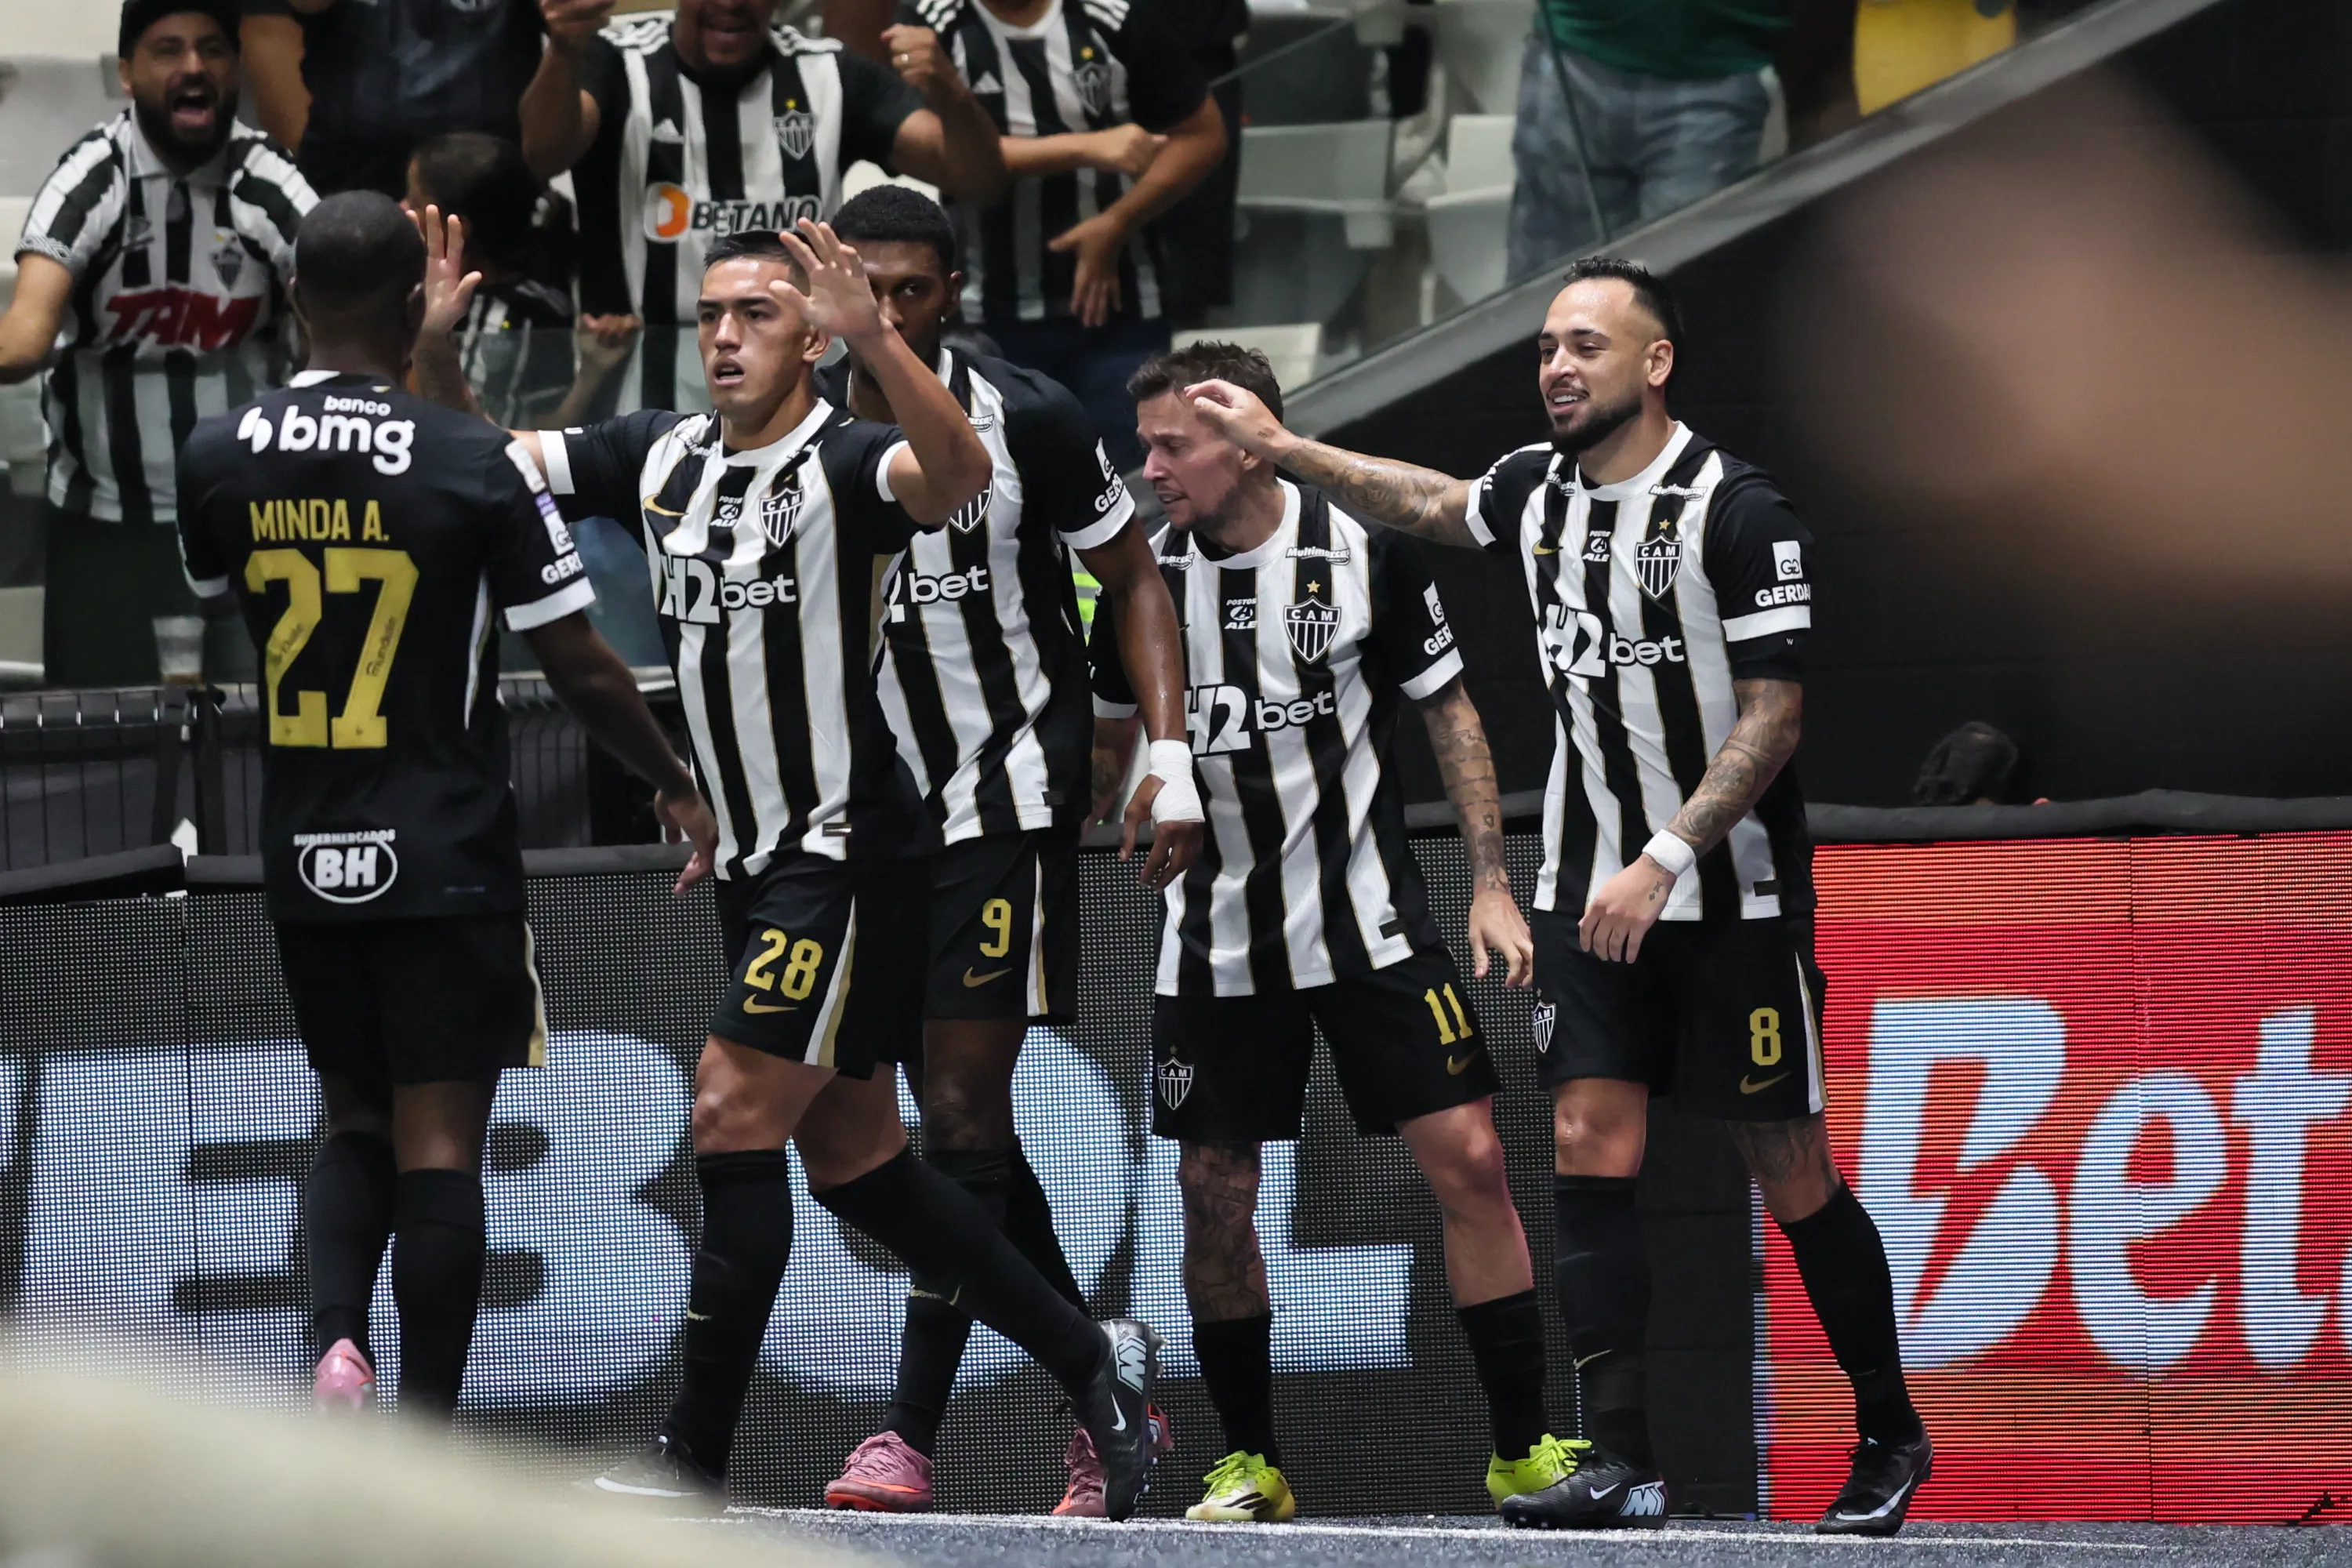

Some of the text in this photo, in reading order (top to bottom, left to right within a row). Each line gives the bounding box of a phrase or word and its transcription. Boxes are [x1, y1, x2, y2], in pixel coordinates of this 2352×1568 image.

[691, 198, 819, 233] BETANO
[105, 286, 262, 350] TAM
[324, 395, 391, 416] banco
[278, 405, 416, 476] bmg
[249, 499, 390, 542] MINDA A.
[767, 493, 800, 511] CAM
[1582, 553, 1610, 562] ALE
[1641, 546, 1676, 557] CAM
[1226, 597, 1257, 606] POSTOS
[1290, 609, 1334, 622] CAM
[1225, 621, 1258, 630] ALE
[244, 547, 420, 750] 27
[315, 846, 379, 889] BH
[979, 898, 1012, 958] 9
[744, 927, 823, 1000] 28
[1424, 982, 1473, 1045] 11
[1749, 1007, 1782, 1066] 8
[1160, 1068, 1188, 1078] CAM
[1858, 997, 2352, 1378] Bet
[0, 1029, 1414, 1408] EBOL
